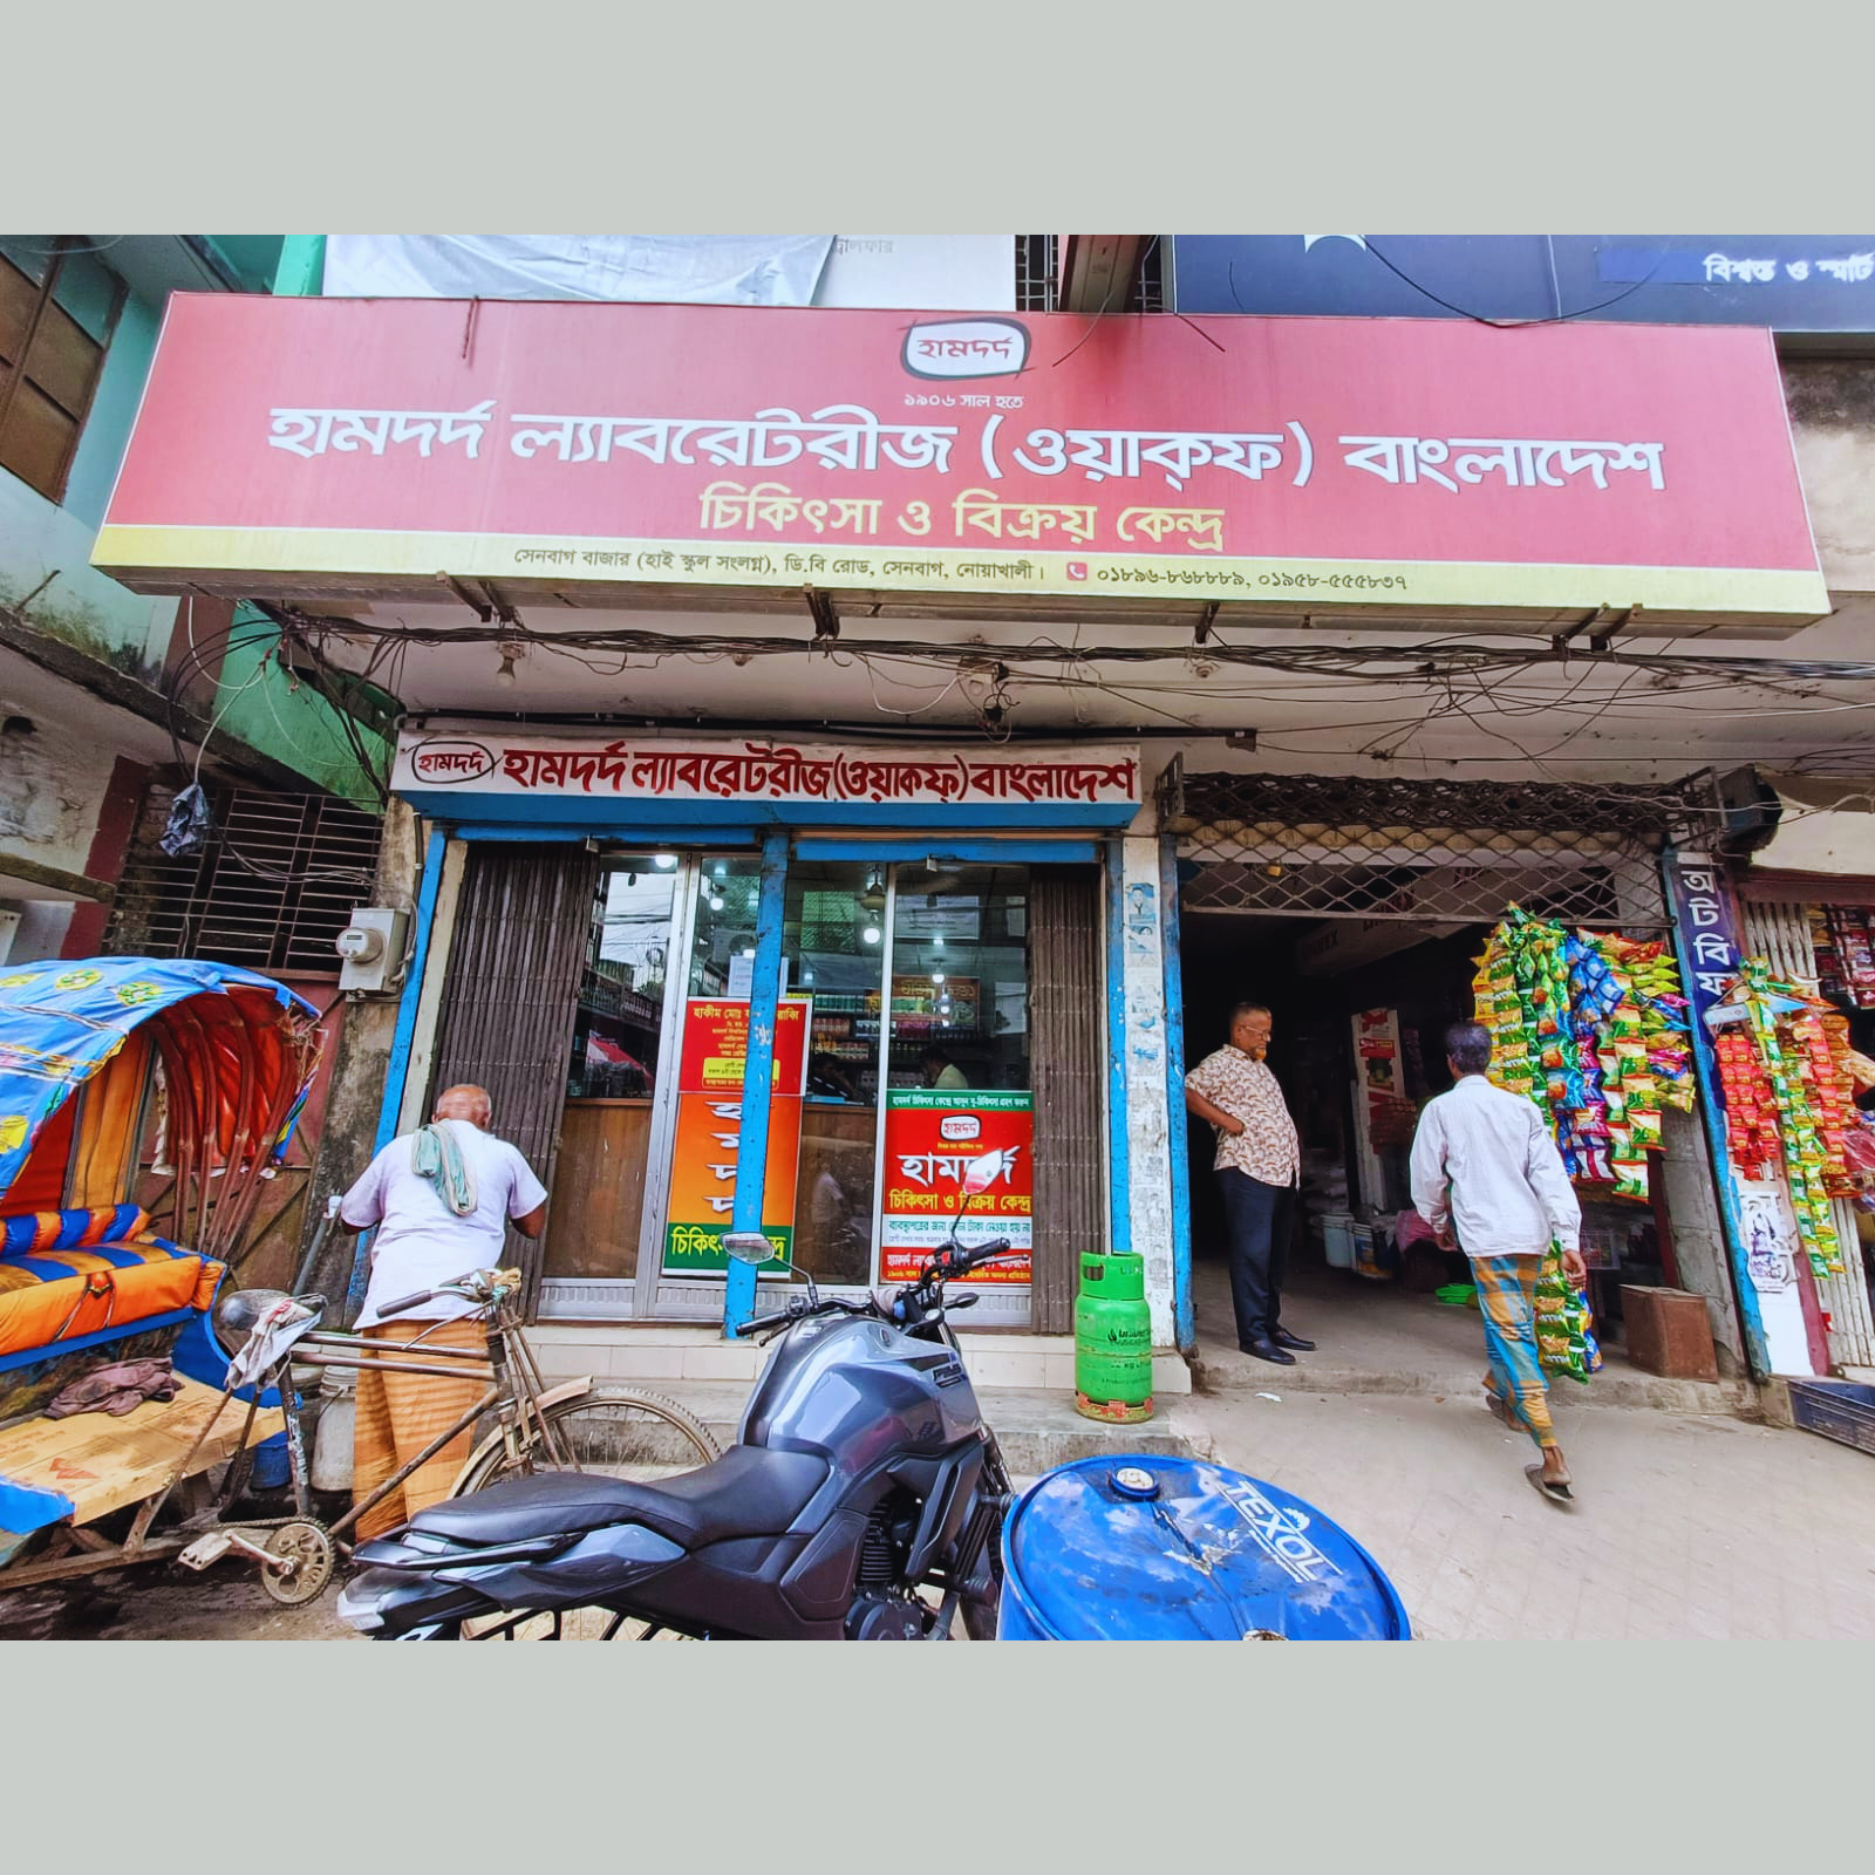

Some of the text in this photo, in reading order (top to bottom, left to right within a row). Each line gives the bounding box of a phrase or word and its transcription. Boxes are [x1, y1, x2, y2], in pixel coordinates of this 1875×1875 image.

[1785, 260, 1810, 281] ও
[916, 336, 1013, 359] হামদর্দ
[904, 393, 1024, 410] ১৯০৬ সাল হতে
[267, 400, 497, 459] হামদর্দ
[510, 403, 958, 473] ল্যাবরেটরীজ
[1338, 435, 1666, 493] বাংলাদেশ
[699, 481, 1226, 553] চিকিৎসা ও বিক্রয় কেন্দ্র
[514, 548, 576, 566] সেনবাগ
[581, 550, 630, 567] বাজার
[636, 551, 675, 570] (হাই
[680, 553, 709, 573] স্কুল
[716, 554, 777, 575] সংলগ্ন),
[784, 553, 827, 573] ডি.বি
[832, 558, 875, 577] রোড,
[882, 559, 949, 580] সেনবাগ,
[1097, 566, 1251, 589] ০১৮৯৬-৮৬৮৮৮৯,
[1258, 571, 1407, 591] ০১৯৫৮-৫৫৫৮৩৭
[417, 750, 485, 774] হামদর্দ
[503, 741, 629, 792] হামদর্দ
[968, 757, 1139, 802] বাংলাদেশ
[889, 1188, 938, 1211] চিকিৎসা
[943, 1193, 955, 1209] ও
[1000, 1195, 1032, 1213] কেন্দ্র
[1226, 1480, 1325, 1582] TEXOL
